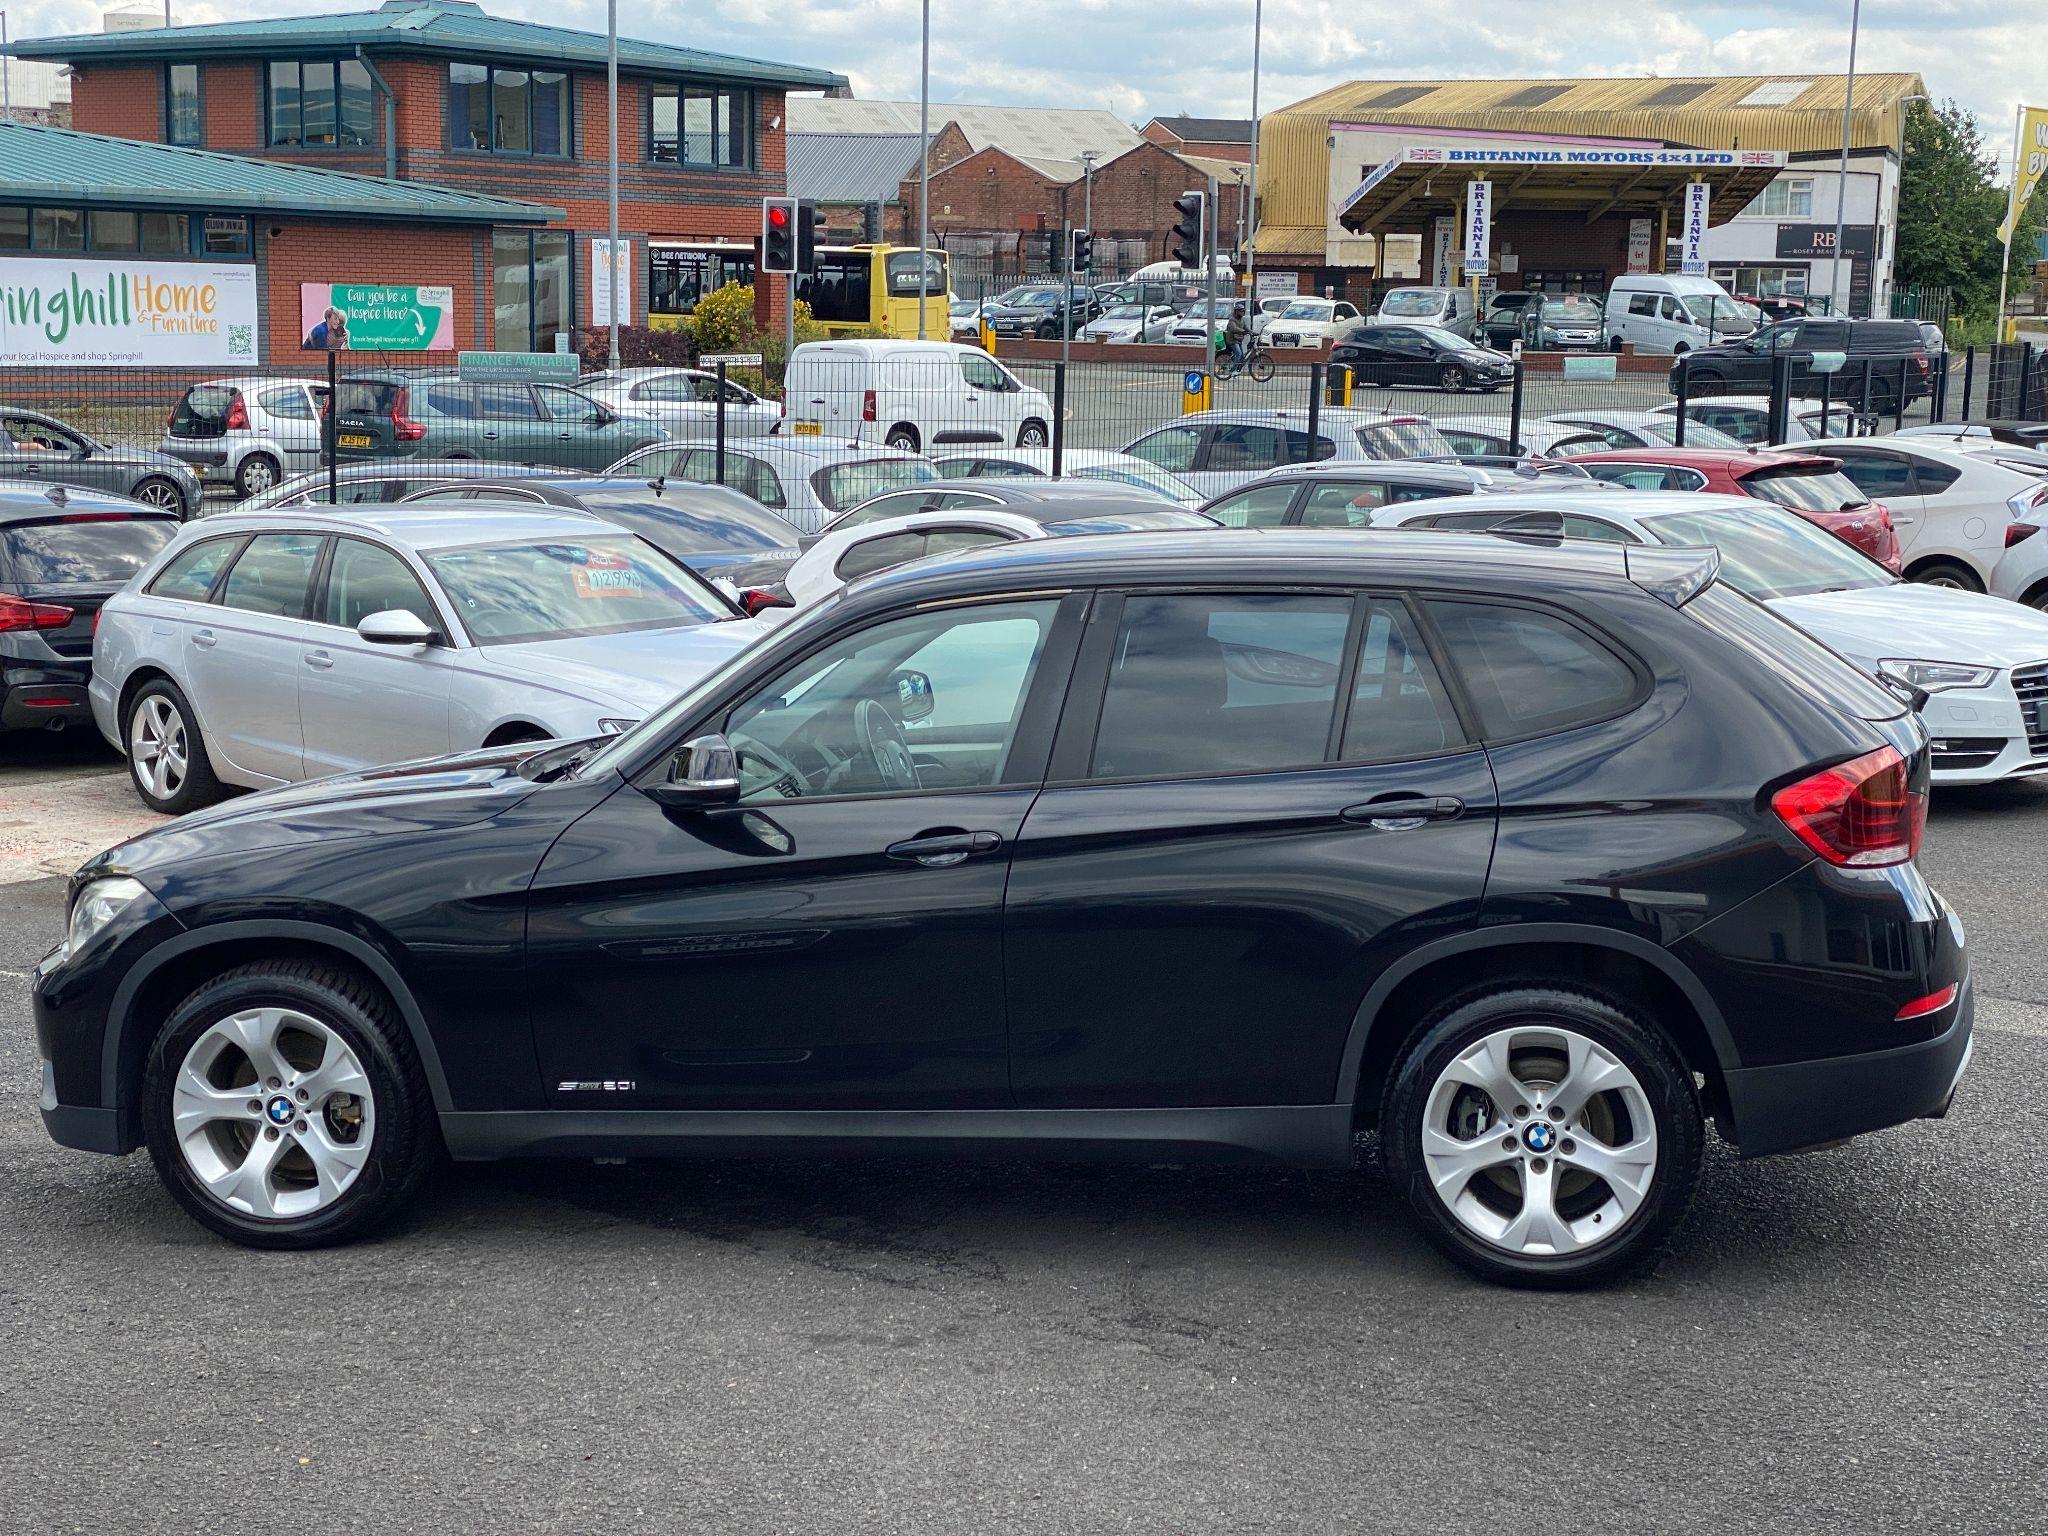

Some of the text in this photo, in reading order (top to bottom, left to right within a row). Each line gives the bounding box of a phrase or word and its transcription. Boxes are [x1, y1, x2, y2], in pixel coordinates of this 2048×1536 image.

[1449, 151, 1734, 164] BRITANNIA MOTORS 4x4 LTD
[1472, 183, 1485, 258] BRITANNIA
[1688, 185, 1704, 259] BRITANNIA
[1812, 232, 1837, 247] RB
[660, 251, 708, 260] BEE NETWORK
[1465, 259, 1488, 270] MOTORS
[1682, 261, 1705, 272] MOTORS
[133, 274, 217, 314] Home
[347, 288, 408, 306] Can you be a
[138, 310, 218, 334] & Furniture
[347, 306, 409, 323] Hospice Hero?
[18, 352, 38, 361] local
[39, 351, 70, 362] Hospice
[71, 352, 85, 361] and
[86, 352, 107, 362] shop
[108, 352, 144, 363] Springhill
[461, 354, 577, 367] FINANCE AVAILABLE
